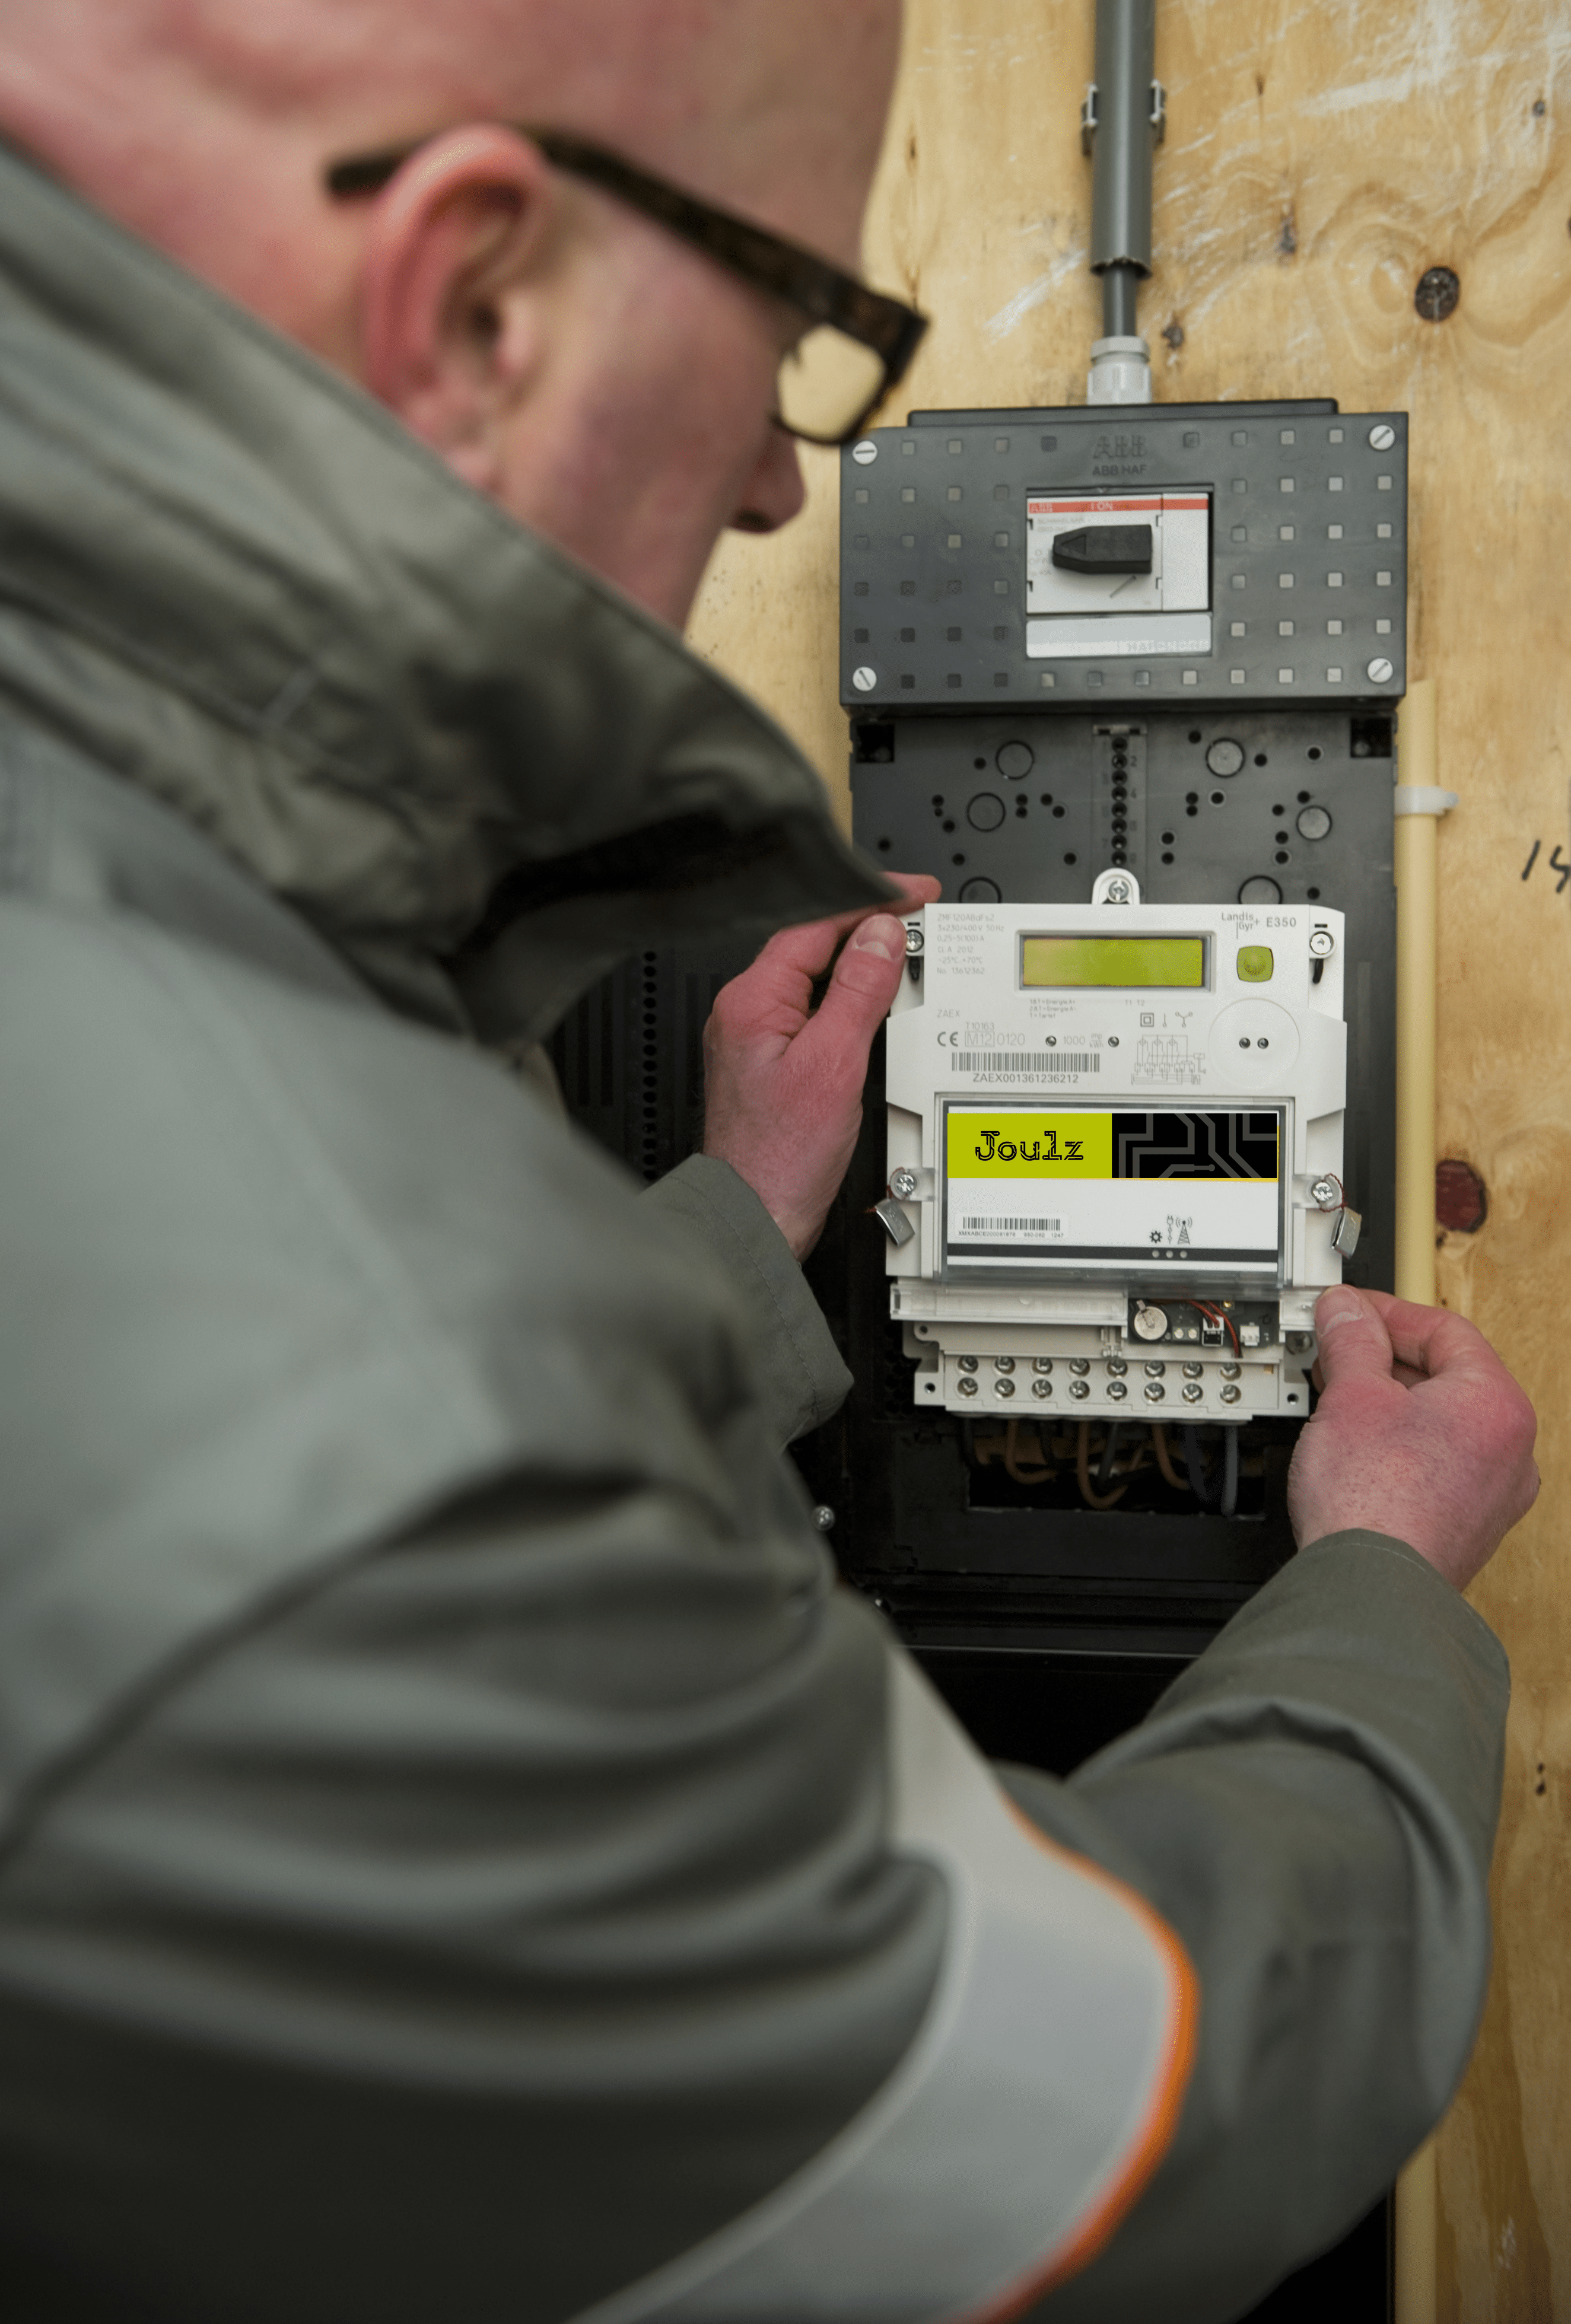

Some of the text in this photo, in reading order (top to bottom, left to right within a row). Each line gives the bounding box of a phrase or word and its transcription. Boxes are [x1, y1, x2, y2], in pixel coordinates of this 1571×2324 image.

[1092, 434, 1147, 459] ABB
[1092, 464, 1147, 476] ABB HAF
[1096, 501, 1114, 511] ON
[1130, 755, 1137, 768] 2
[1130, 787, 1137, 798] 4
[1238, 921, 1254, 932] Gyr
[1266, 916, 1297, 928] E350
[951, 966, 985, 975] 13612362
[937, 1009, 961, 1018] ZAEX
[965, 1021, 996, 1030] T10163
[967, 1032, 993, 1046] M12
[997, 1032, 1026, 1046] 0120
[1063, 1035, 1086, 1046] 1000
[1089, 1040, 1104, 1049] kWh
[972, 1072, 1079, 1084] ZAEX001361236212
[975, 1130, 1085, 1161] Joulz
